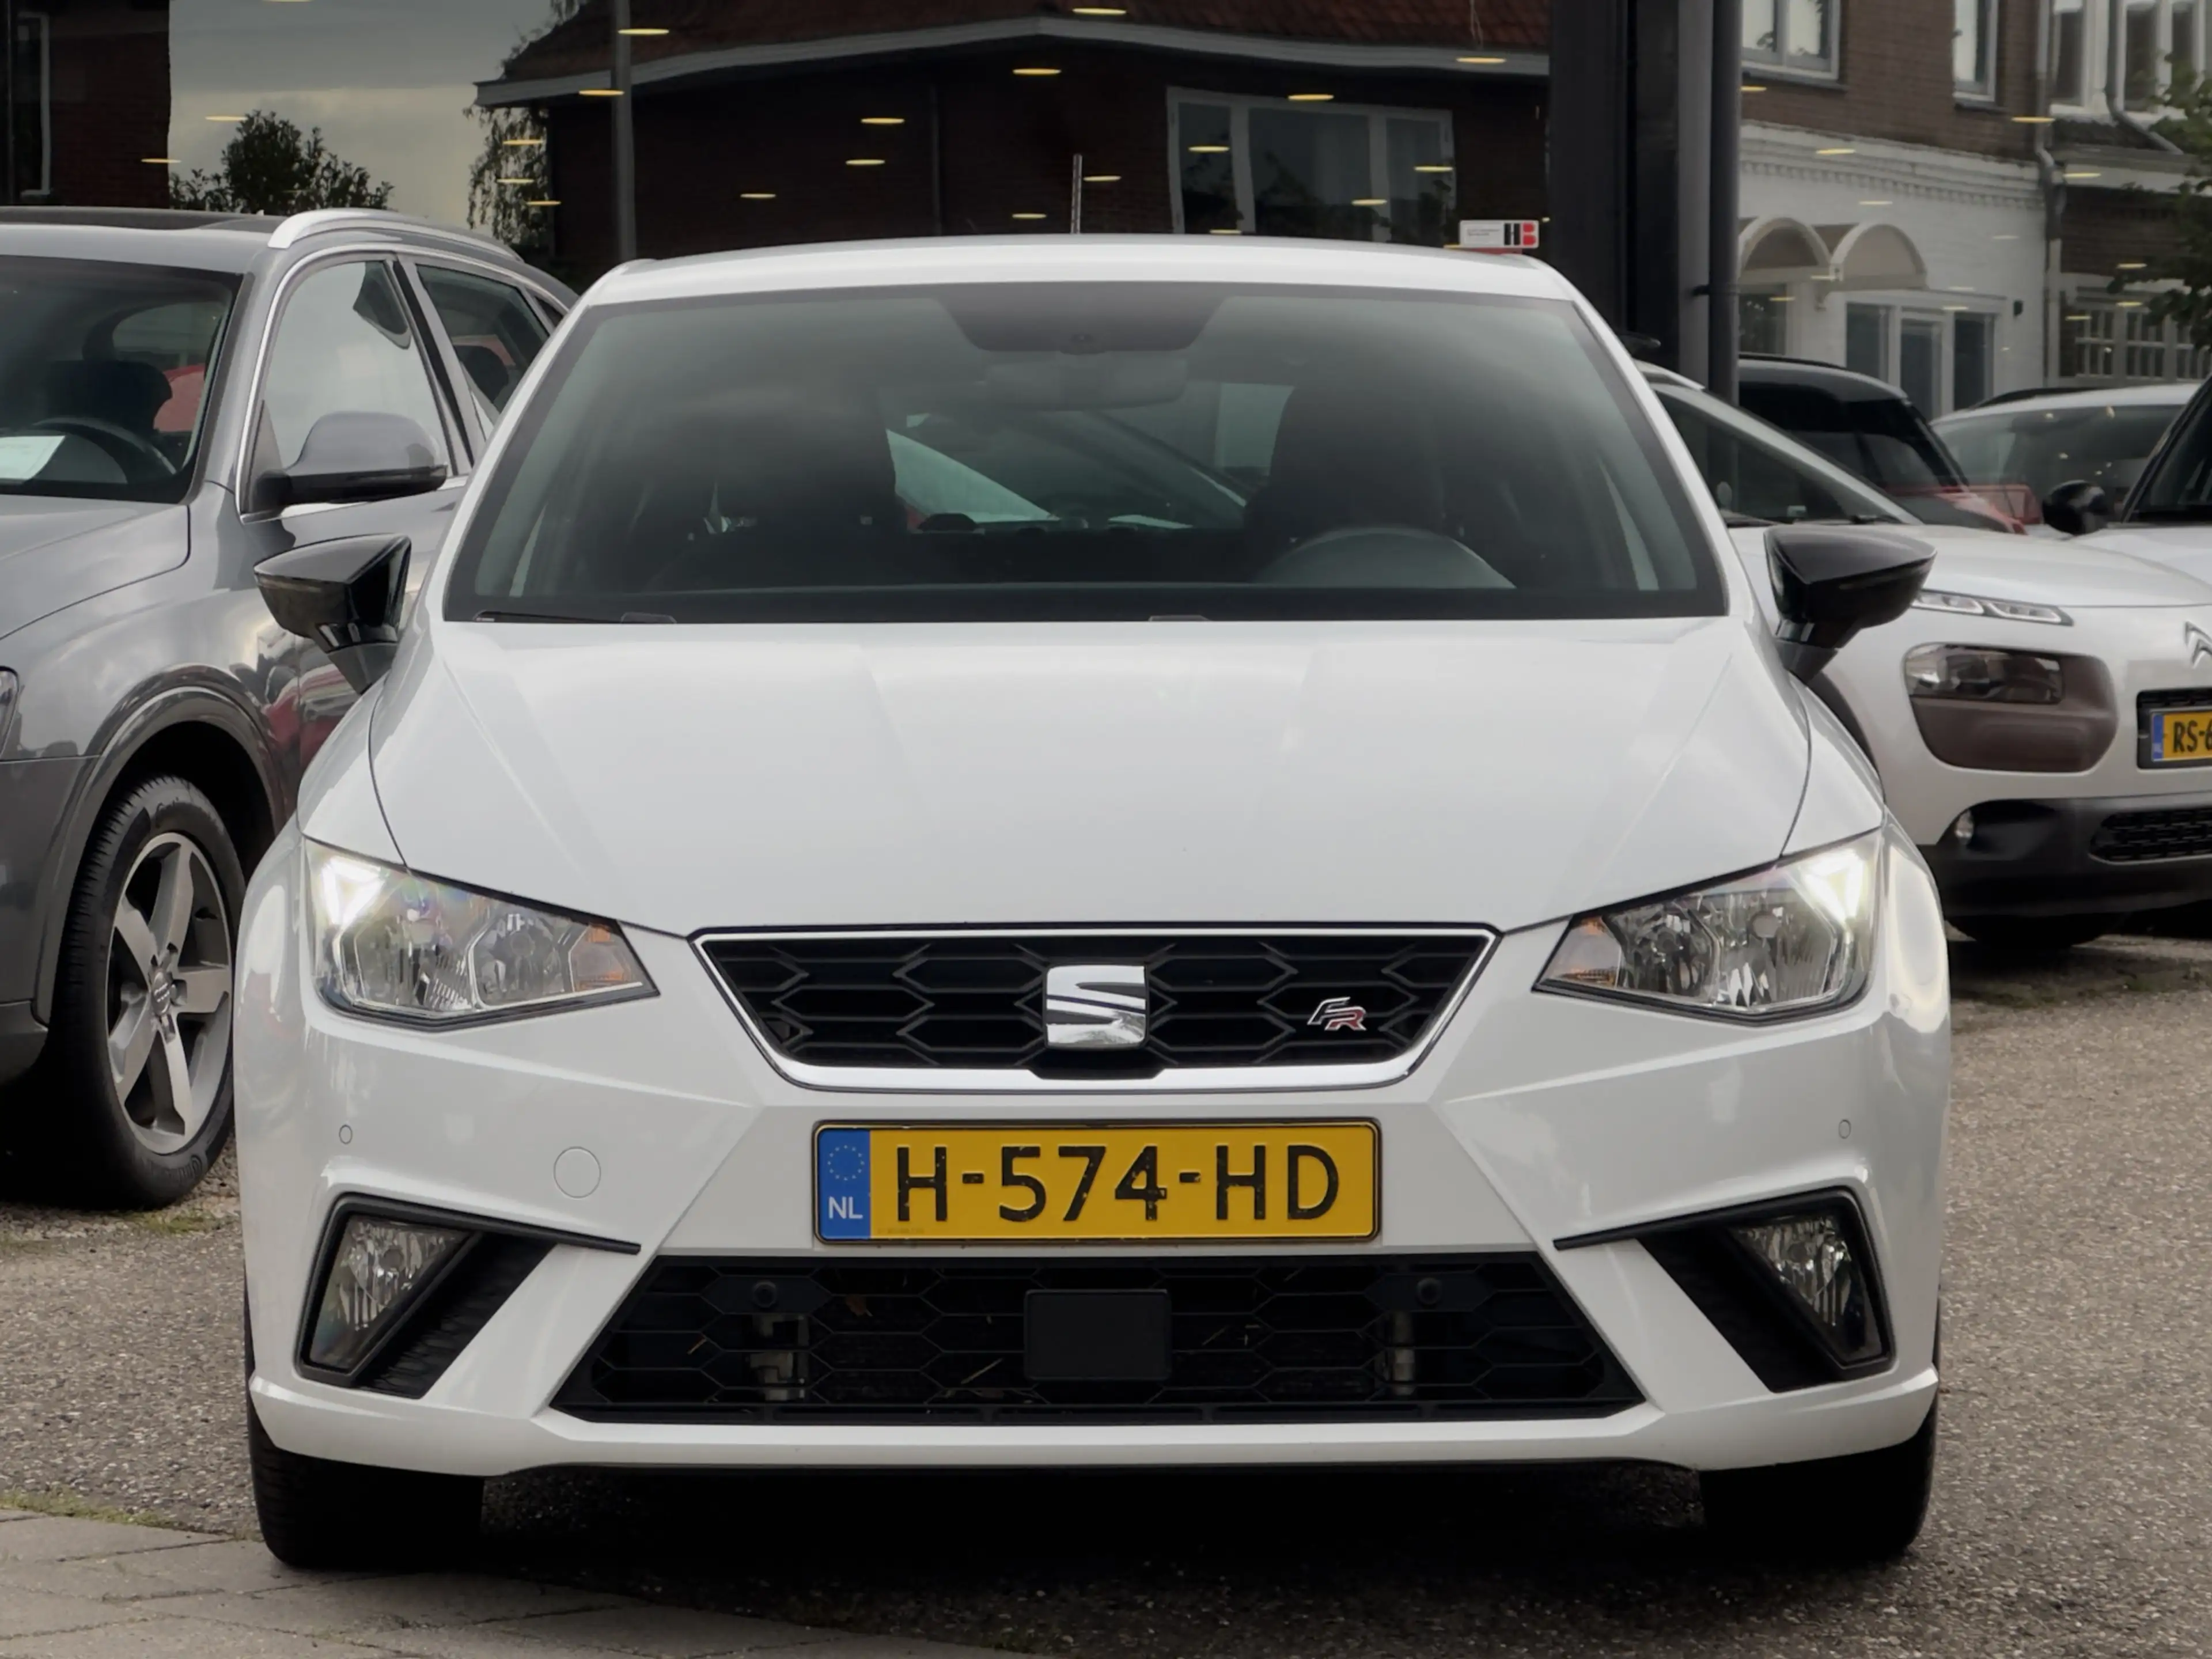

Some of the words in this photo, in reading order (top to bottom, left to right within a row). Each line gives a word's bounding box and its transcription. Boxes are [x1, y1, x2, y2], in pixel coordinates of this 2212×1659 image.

[1306, 997, 1366, 1031] FR
[896, 1145, 1339, 1222] H-574-HD
[828, 1196, 863, 1219] NL
